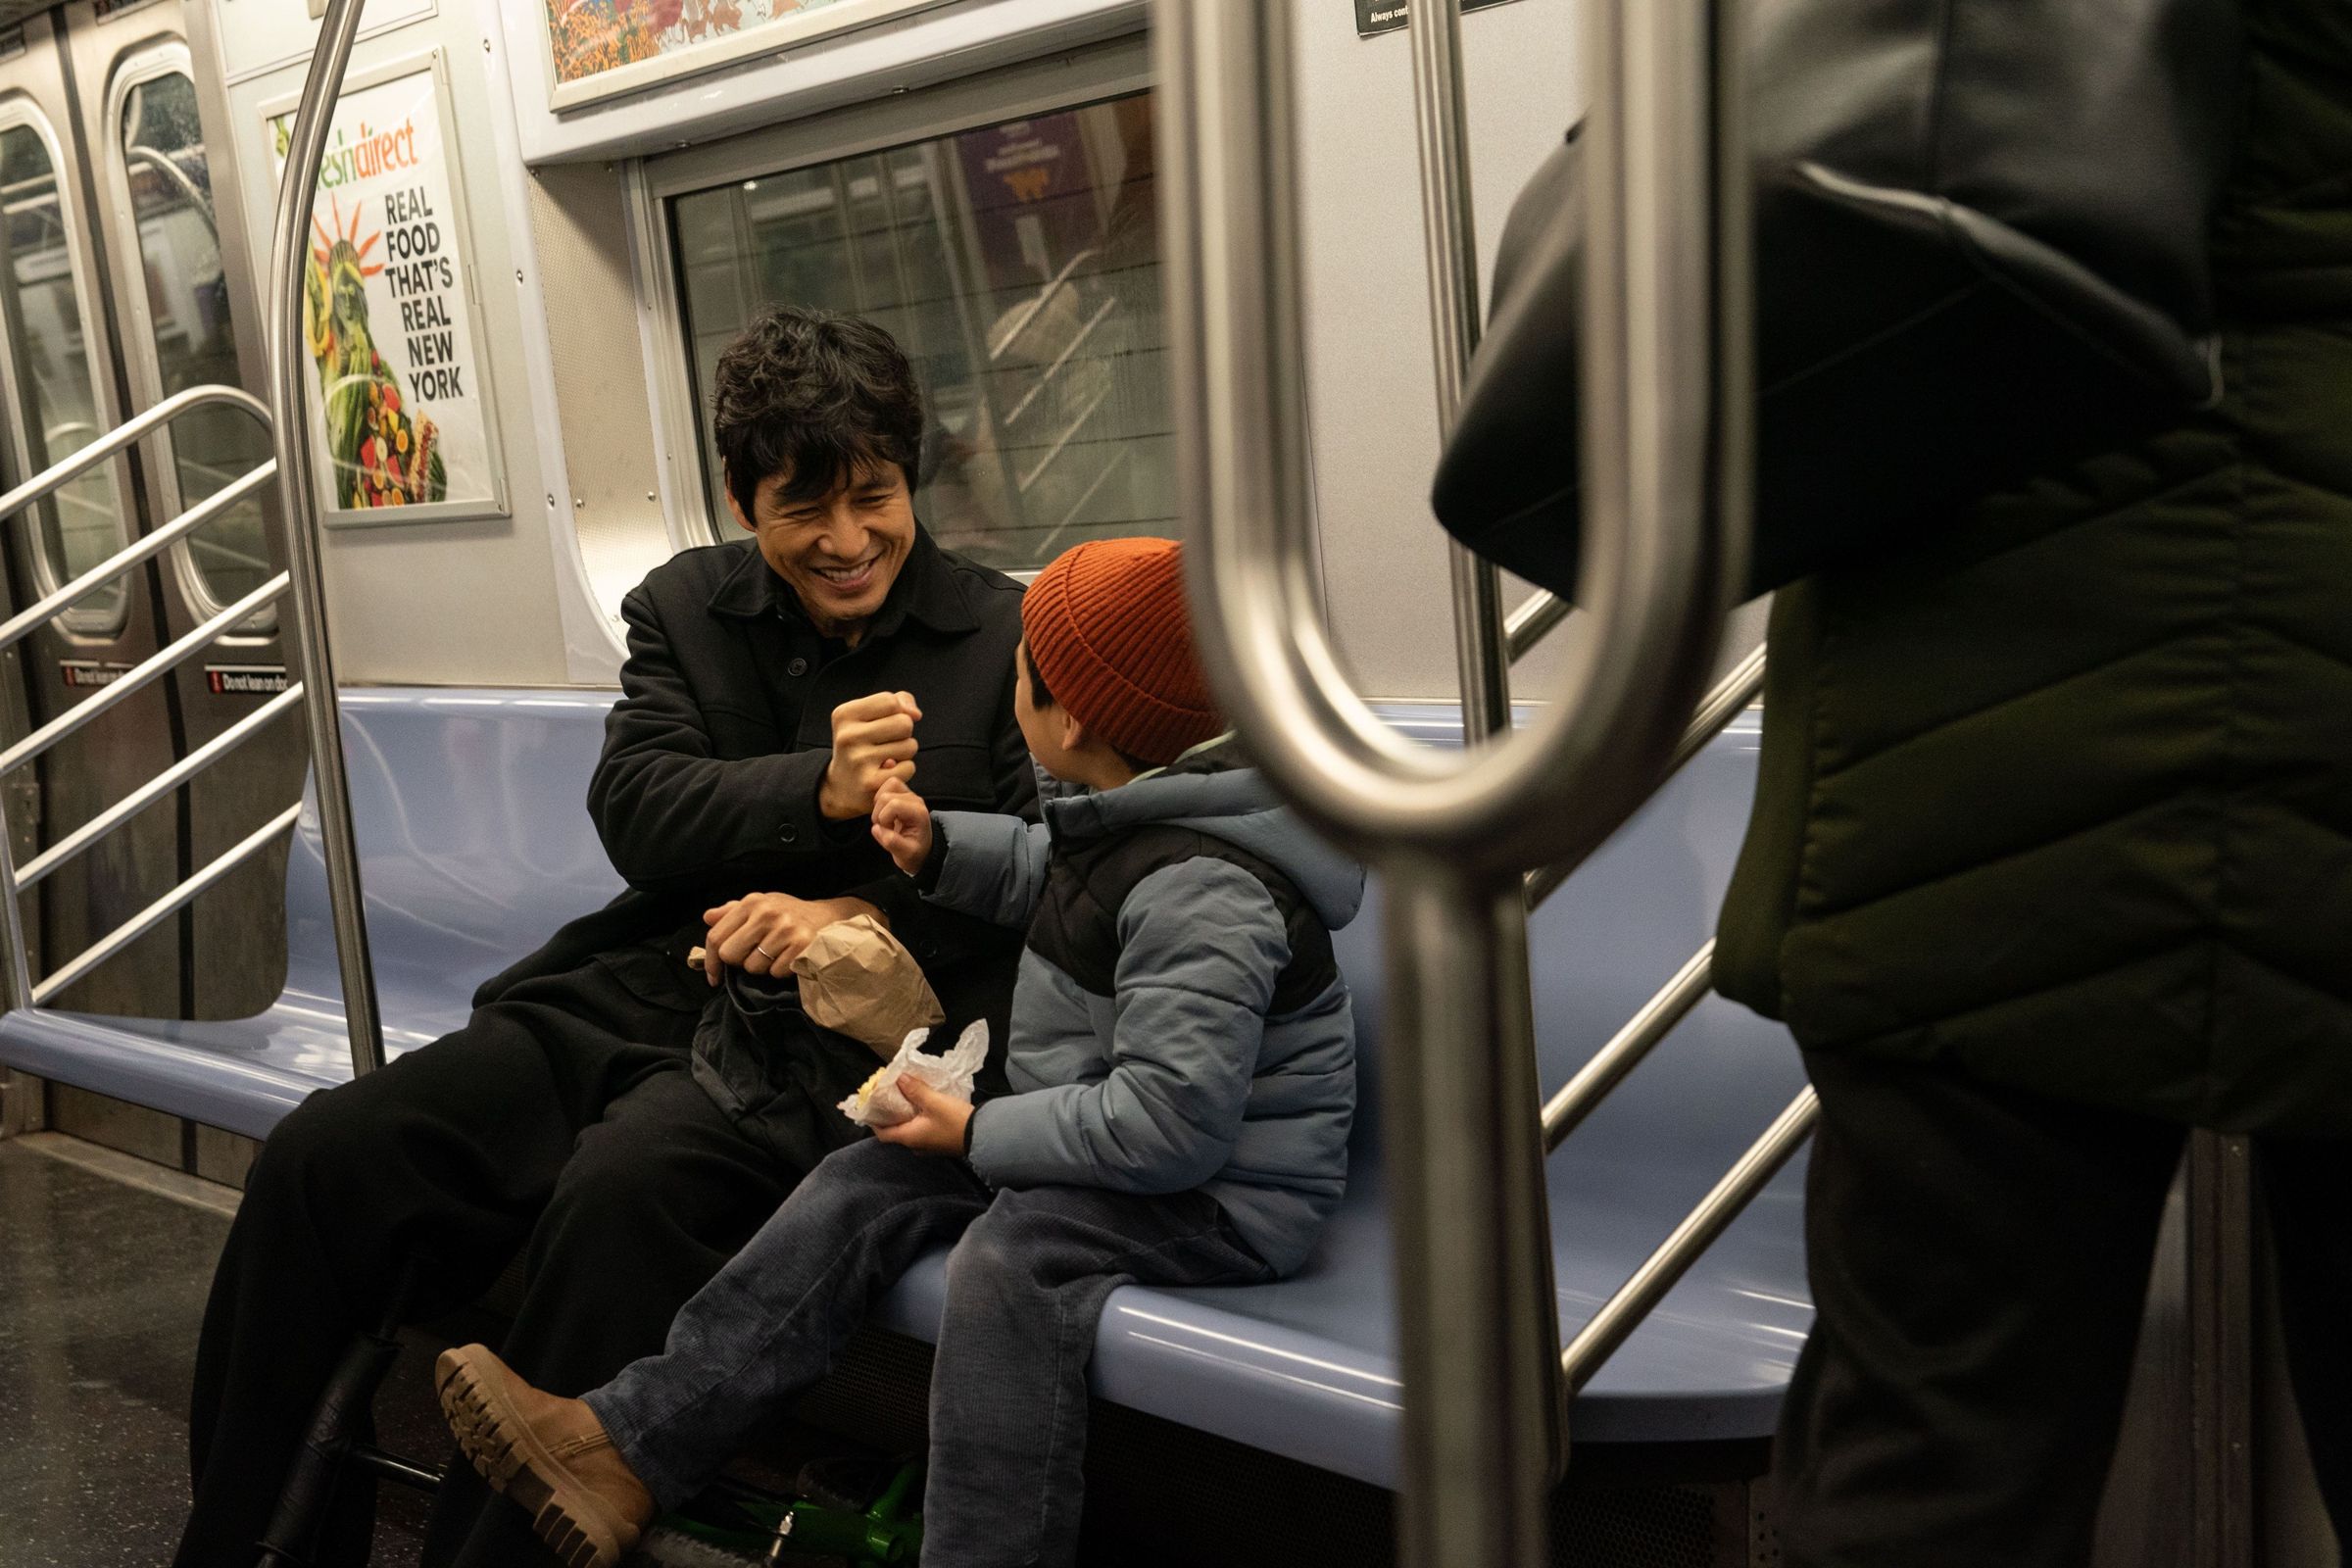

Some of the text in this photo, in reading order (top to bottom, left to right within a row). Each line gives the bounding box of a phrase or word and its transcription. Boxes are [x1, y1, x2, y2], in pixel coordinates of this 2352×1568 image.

[1370, 5, 1409, 24] Always cont
[318, 118, 418, 191] eshdirect
[384, 185, 433, 225] REAL
[386, 221, 441, 263] FOOD
[384, 256, 454, 298] THAT'S
[400, 295, 452, 333] REAL
[407, 330, 453, 368] NEW
[408, 366, 465, 403] YORK
[222, 673, 235, 691] Do
[234, 674, 248, 691] not
